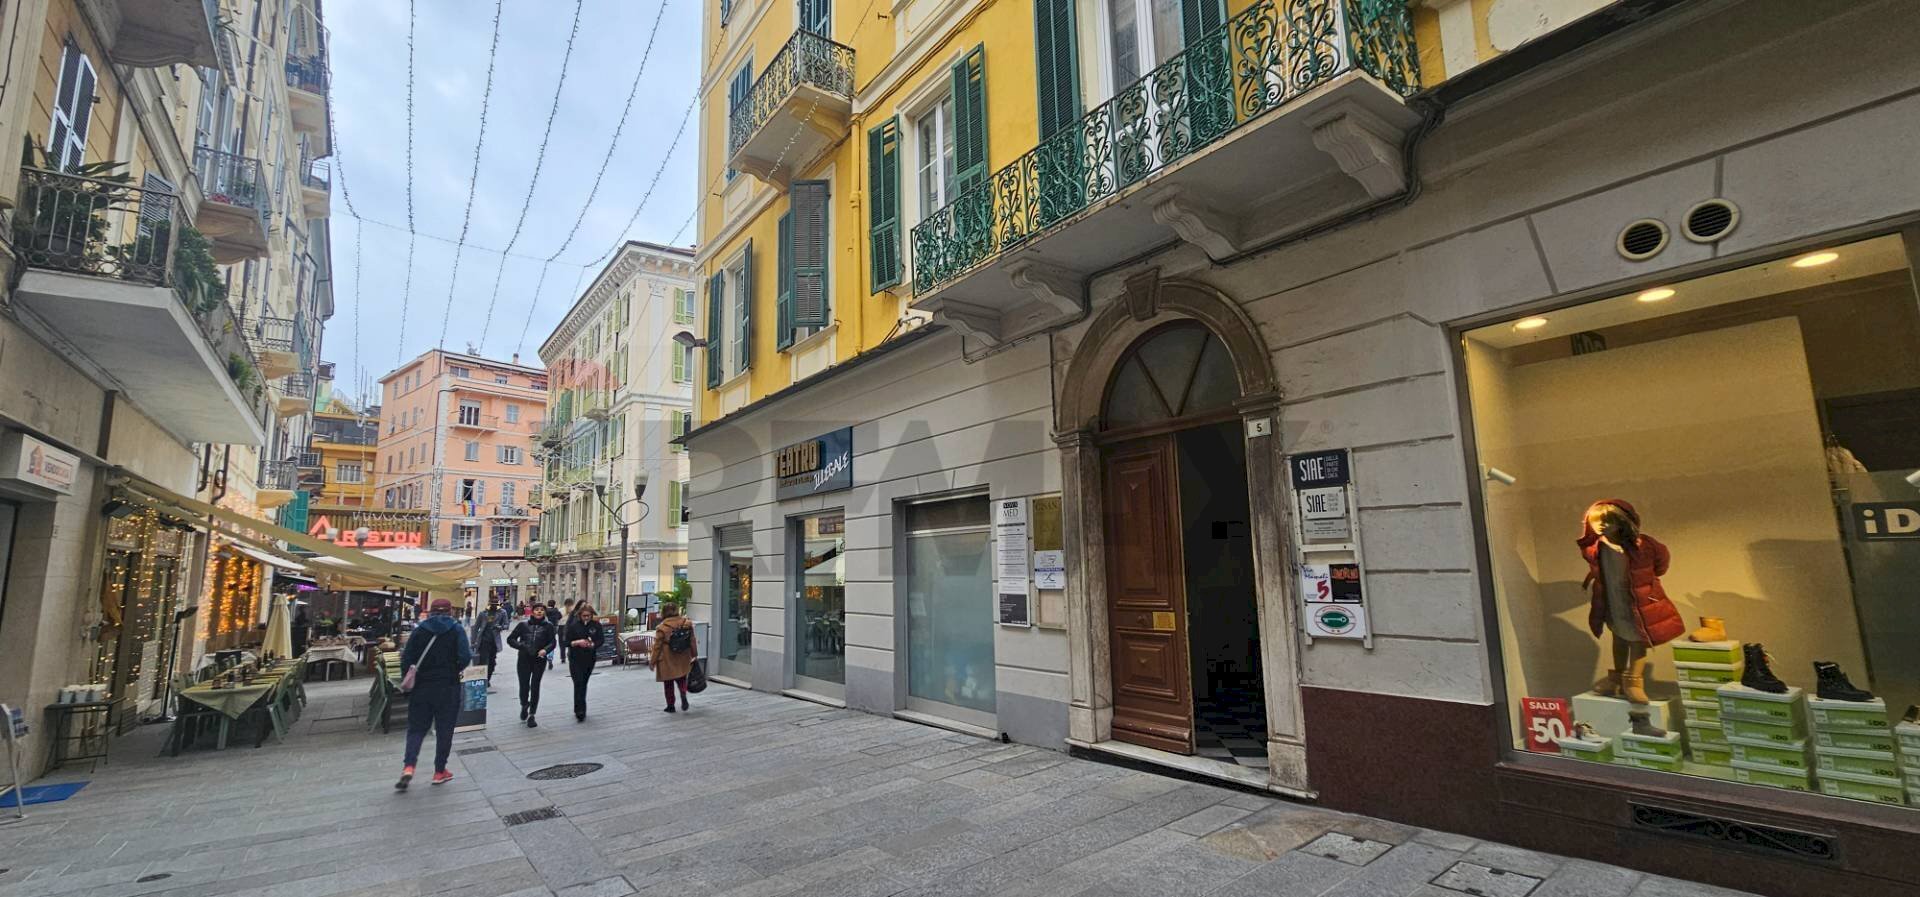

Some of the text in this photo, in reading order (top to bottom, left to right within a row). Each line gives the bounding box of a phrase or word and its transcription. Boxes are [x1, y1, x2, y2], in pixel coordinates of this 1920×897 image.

[1256, 423, 1263, 433] 5
[776, 440, 819, 478] TEATRO
[814, 451, 849, 490] ILLEGALE
[1299, 457, 1325, 481] SIAE
[1003, 509, 1018, 517] MED
[1306, 494, 1327, 513] SIAE
[1317, 580, 1329, 599] 5
[1528, 701, 1560, 711] SALDI
